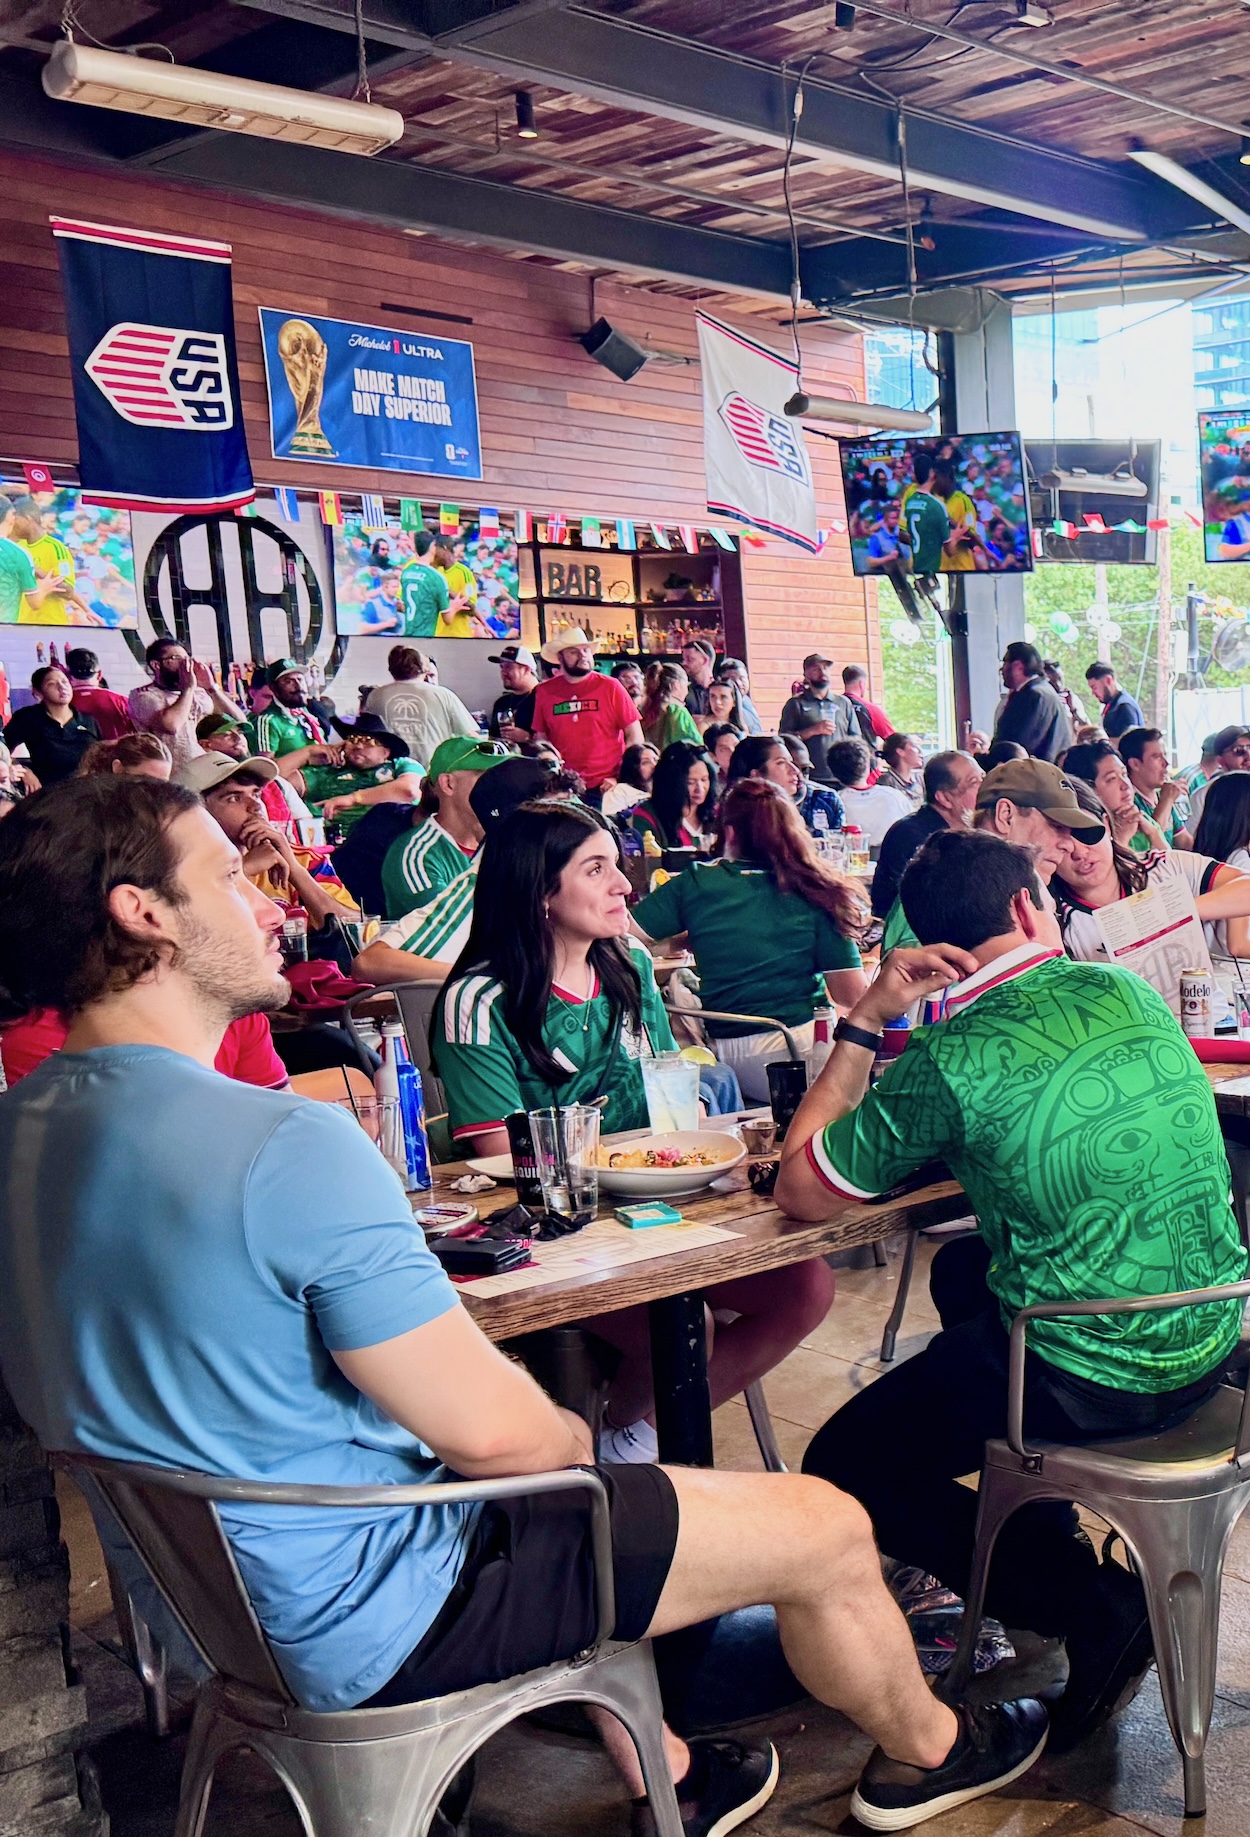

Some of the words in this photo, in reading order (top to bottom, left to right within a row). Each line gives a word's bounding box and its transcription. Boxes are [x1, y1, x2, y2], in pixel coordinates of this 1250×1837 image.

[348, 334, 391, 351] Michelob
[402, 344, 444, 360] ULTRA
[169, 338, 227, 423] USA
[354, 368, 395, 395] MAKE
[397, 375, 446, 403] MATCH
[351, 391, 380, 417] DAY
[384, 396, 453, 427] SUPERIOR
[767, 418, 804, 478] USA
[548, 562, 602, 599] BAR
[406, 583, 419, 621] 5
